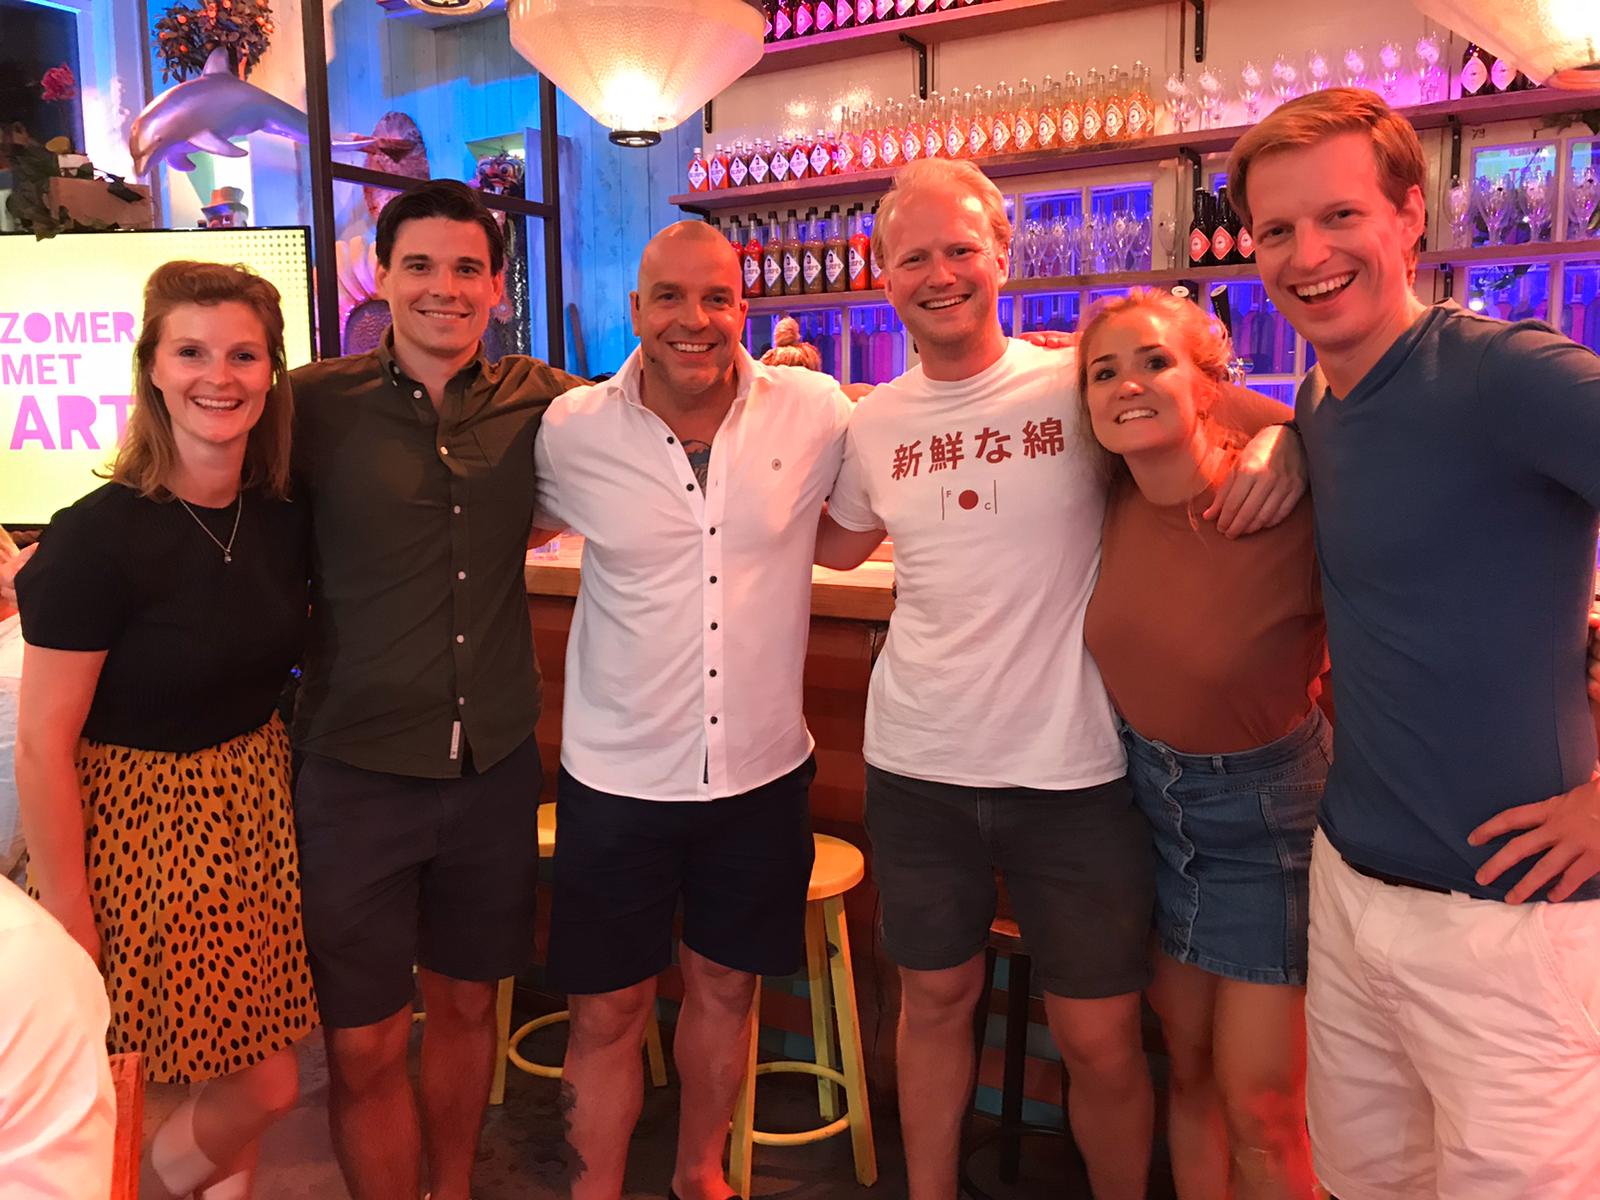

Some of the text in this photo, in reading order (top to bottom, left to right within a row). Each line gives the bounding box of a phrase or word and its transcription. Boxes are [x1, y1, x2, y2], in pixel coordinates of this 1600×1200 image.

[0, 312, 135, 343] ZOMER
[1, 354, 82, 384] MET
[10, 395, 137, 449] ART
[891, 417, 1065, 480] 新鮮な綿
[946, 490, 991, 511] F C
